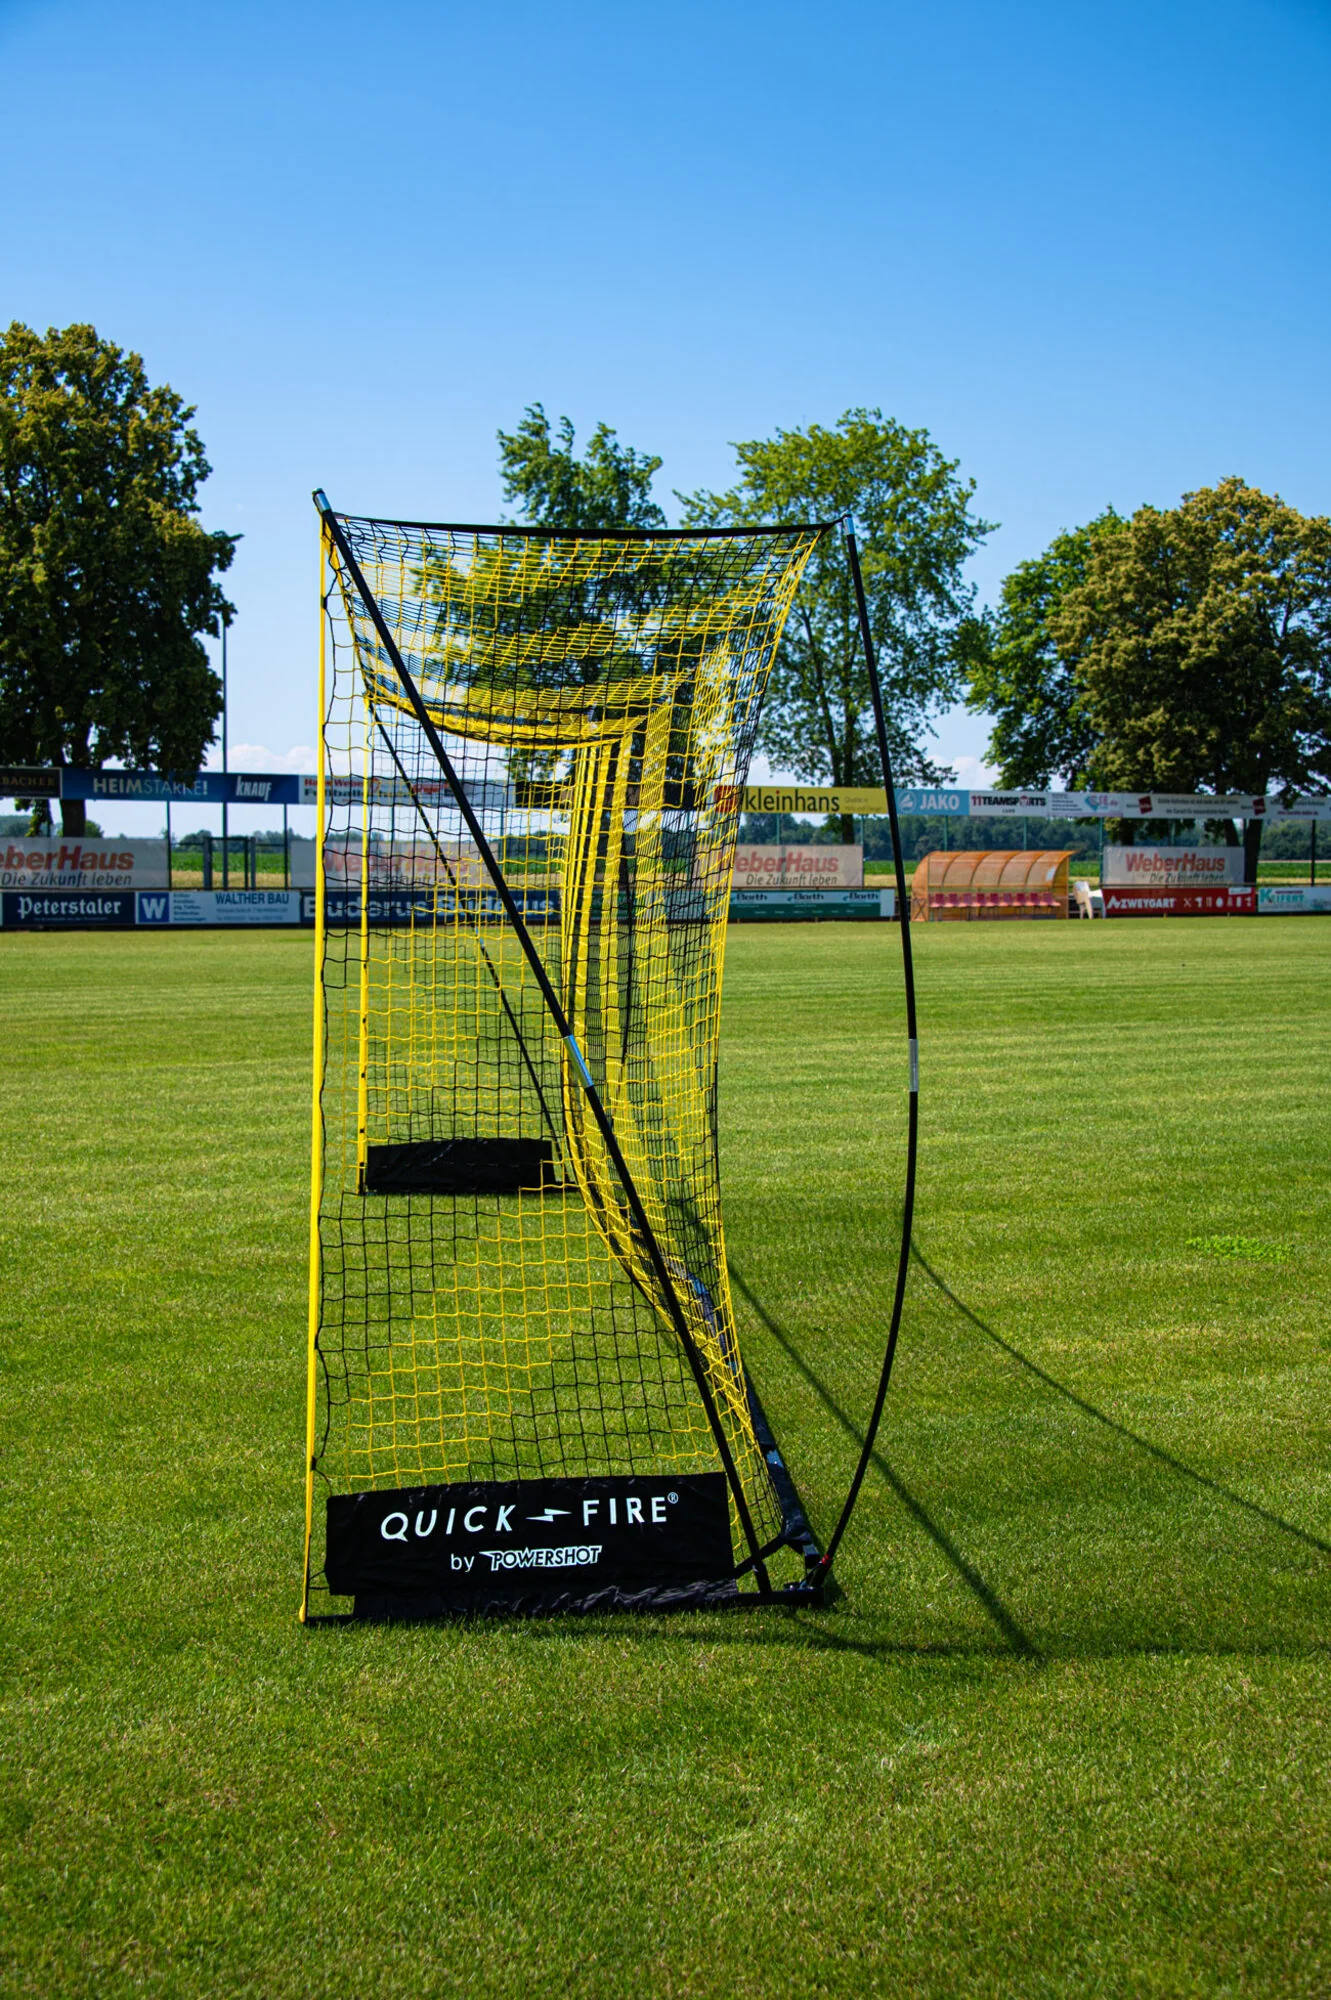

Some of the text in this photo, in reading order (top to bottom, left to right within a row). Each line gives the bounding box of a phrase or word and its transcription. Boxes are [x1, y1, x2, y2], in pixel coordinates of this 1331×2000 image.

[745, 787, 840, 812] kleinhans
[919, 794, 960, 811] JAKO
[1125, 851, 1225, 873] WeberHaus
[2, 872, 132, 888] Die Zukunft leben
[746, 874, 838, 887] Die Zukunft leben
[17, 896, 122, 919] Peterstaler
[141, 897, 166, 919] W
[215, 892, 290, 905] WALTHER BAU
[380, 1504, 516, 1542] QUICK
[450, 1545, 602, 1573] by POWERSHOT
